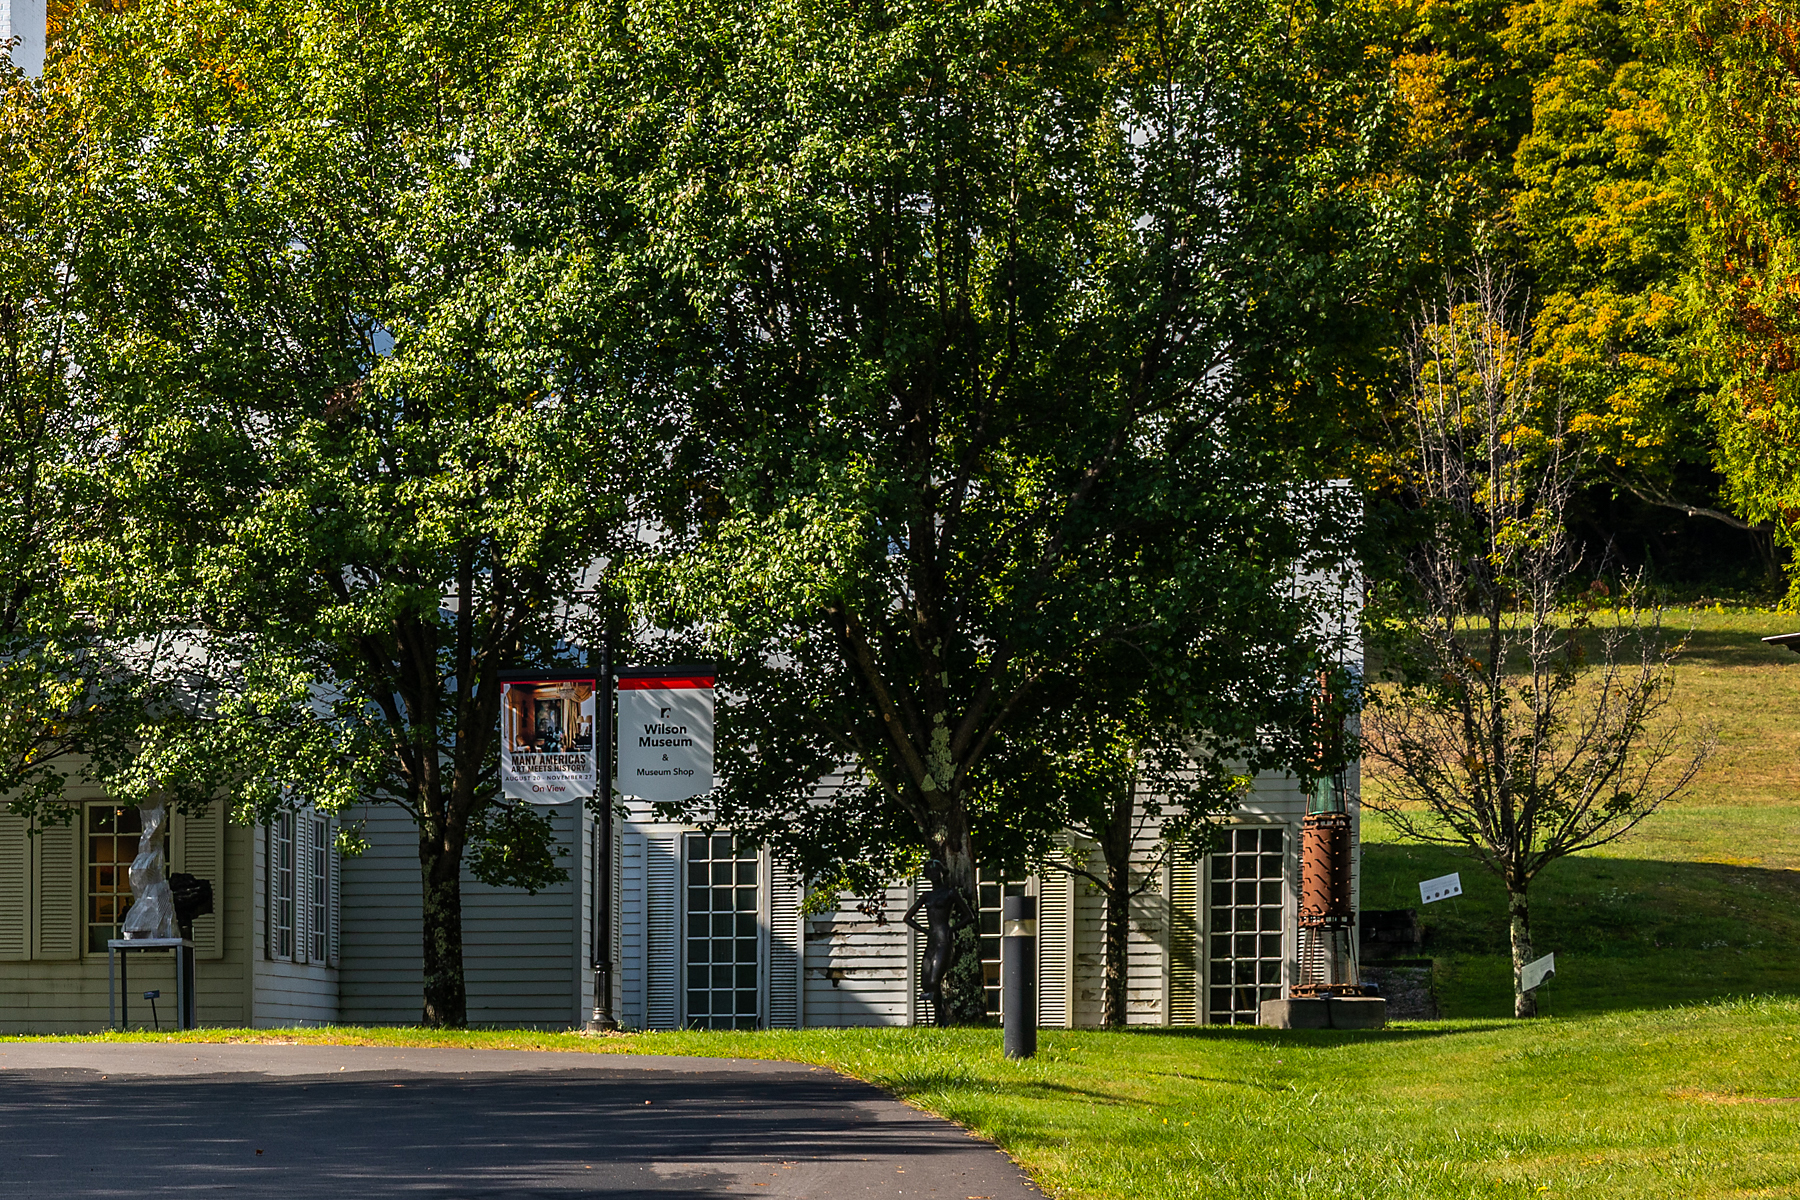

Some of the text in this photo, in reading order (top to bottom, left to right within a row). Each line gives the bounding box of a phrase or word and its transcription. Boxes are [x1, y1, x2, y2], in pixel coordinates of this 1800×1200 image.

[644, 723, 687, 734] Wilson
[639, 736, 693, 747] Museum
[511, 754, 586, 765] MANY AMERICAS
[662, 753, 669, 761] &
[511, 765, 526, 773] ART
[554, 764, 586, 772] HISTORY
[636, 767, 694, 777] Museum Shop
[532, 784, 545, 792] On
